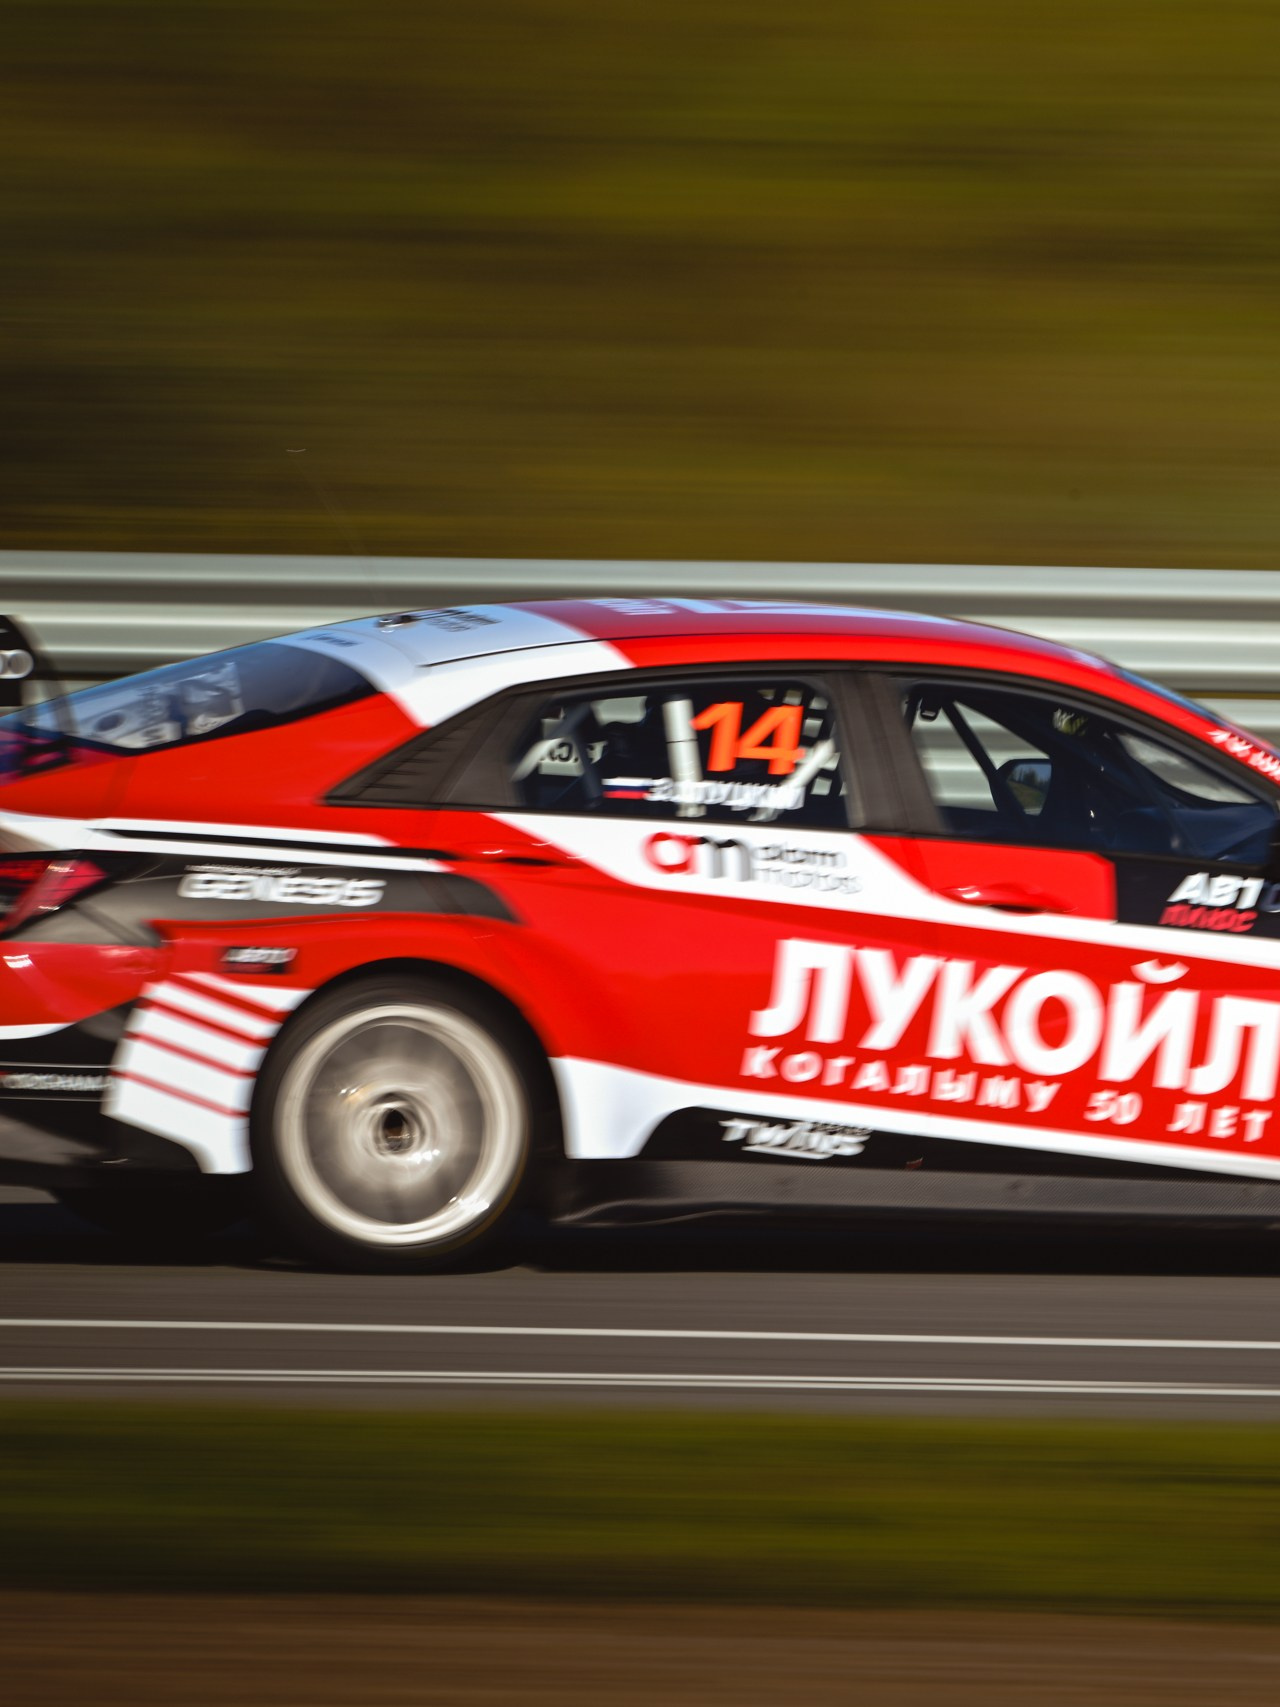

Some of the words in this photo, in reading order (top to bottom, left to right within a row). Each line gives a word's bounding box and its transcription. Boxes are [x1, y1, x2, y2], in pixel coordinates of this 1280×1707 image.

[690, 702, 805, 775] 14
[178, 872, 388, 907] GENESIS
[739, 1045, 1061, 1112] КОГАЛЫМУ
[1084, 1089, 1143, 1125] 50
[1166, 1100, 1273, 1142] ЛЕТ
